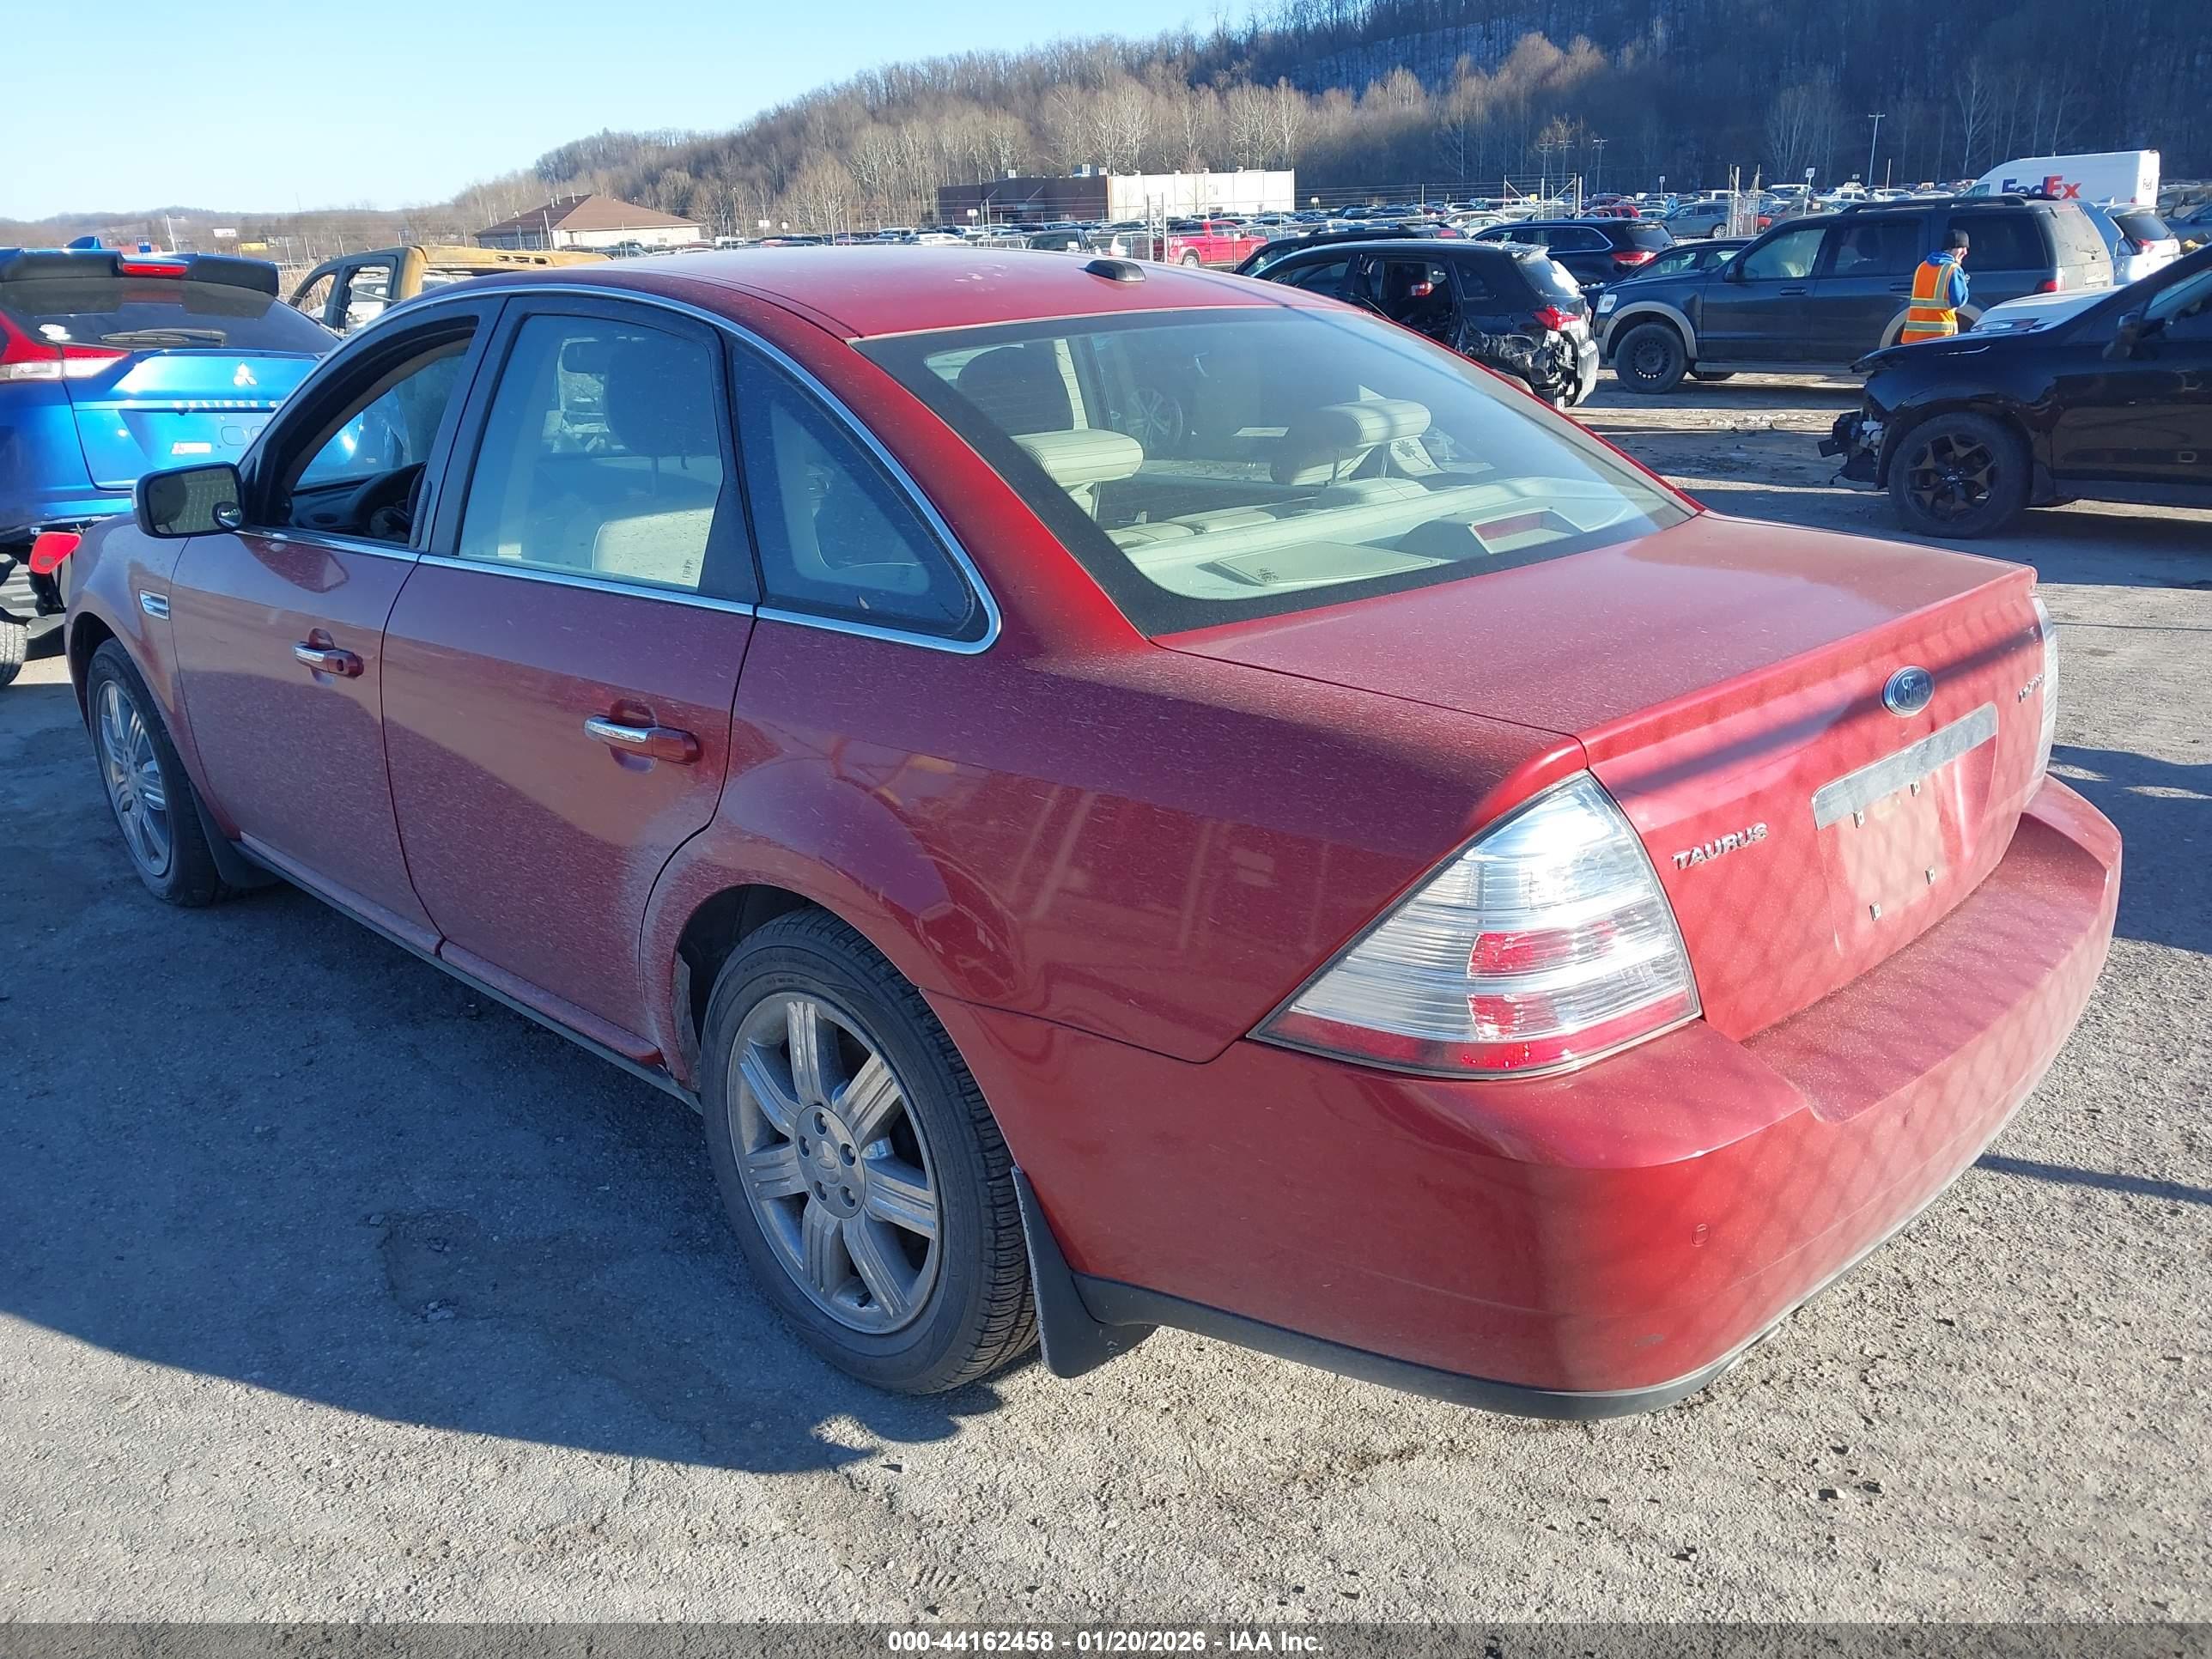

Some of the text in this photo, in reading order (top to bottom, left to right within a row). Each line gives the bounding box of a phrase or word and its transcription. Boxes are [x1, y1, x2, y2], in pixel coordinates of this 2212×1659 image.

[2002, 175, 2081, 200] FedEx
[1901, 673, 1929, 704] Ford
[1671, 822, 1768, 870] TAURUS
